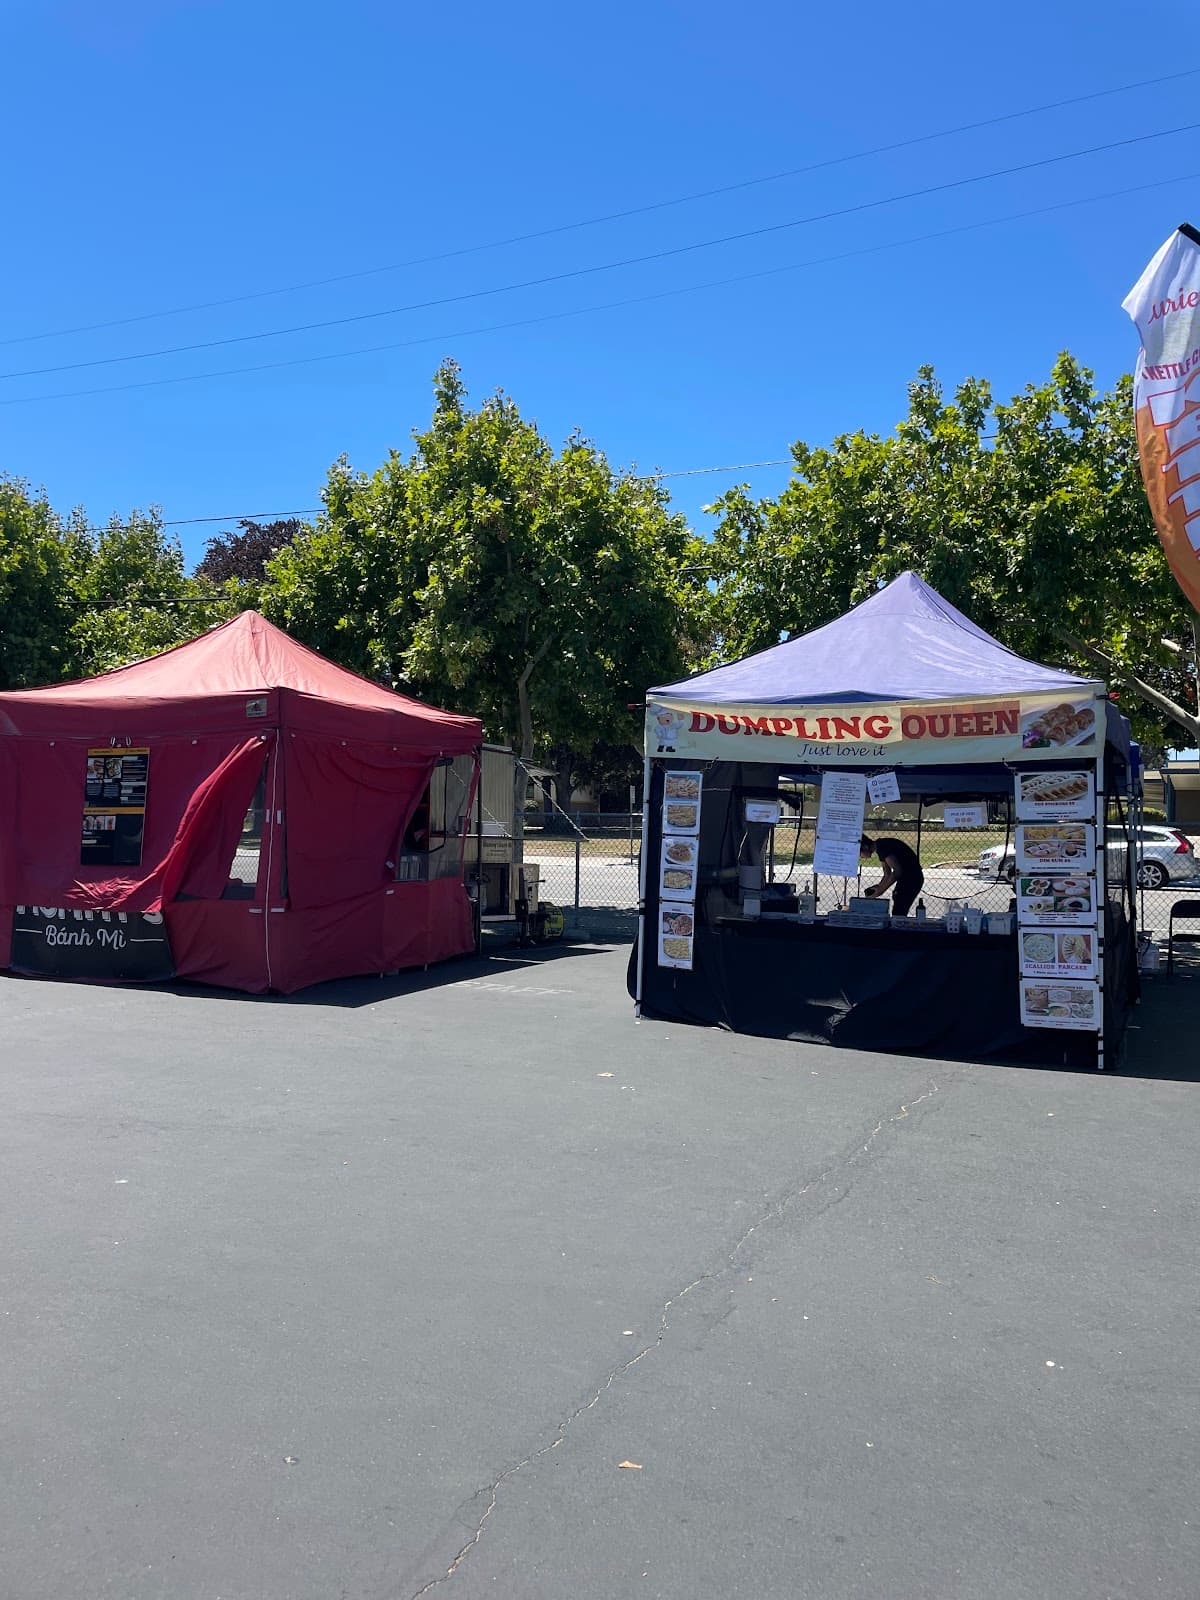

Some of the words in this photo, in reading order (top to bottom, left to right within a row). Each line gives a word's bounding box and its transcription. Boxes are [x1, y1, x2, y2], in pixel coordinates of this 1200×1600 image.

[688, 709, 893, 740] DUMPLING
[901, 708, 1021, 740] QUEEN
[797, 743, 833, 758] Just
[836, 744, 870, 757] love
[872, 743, 887, 757] it
[45, 925, 94, 947] Bánh
[96, 928, 127, 950] Mì
